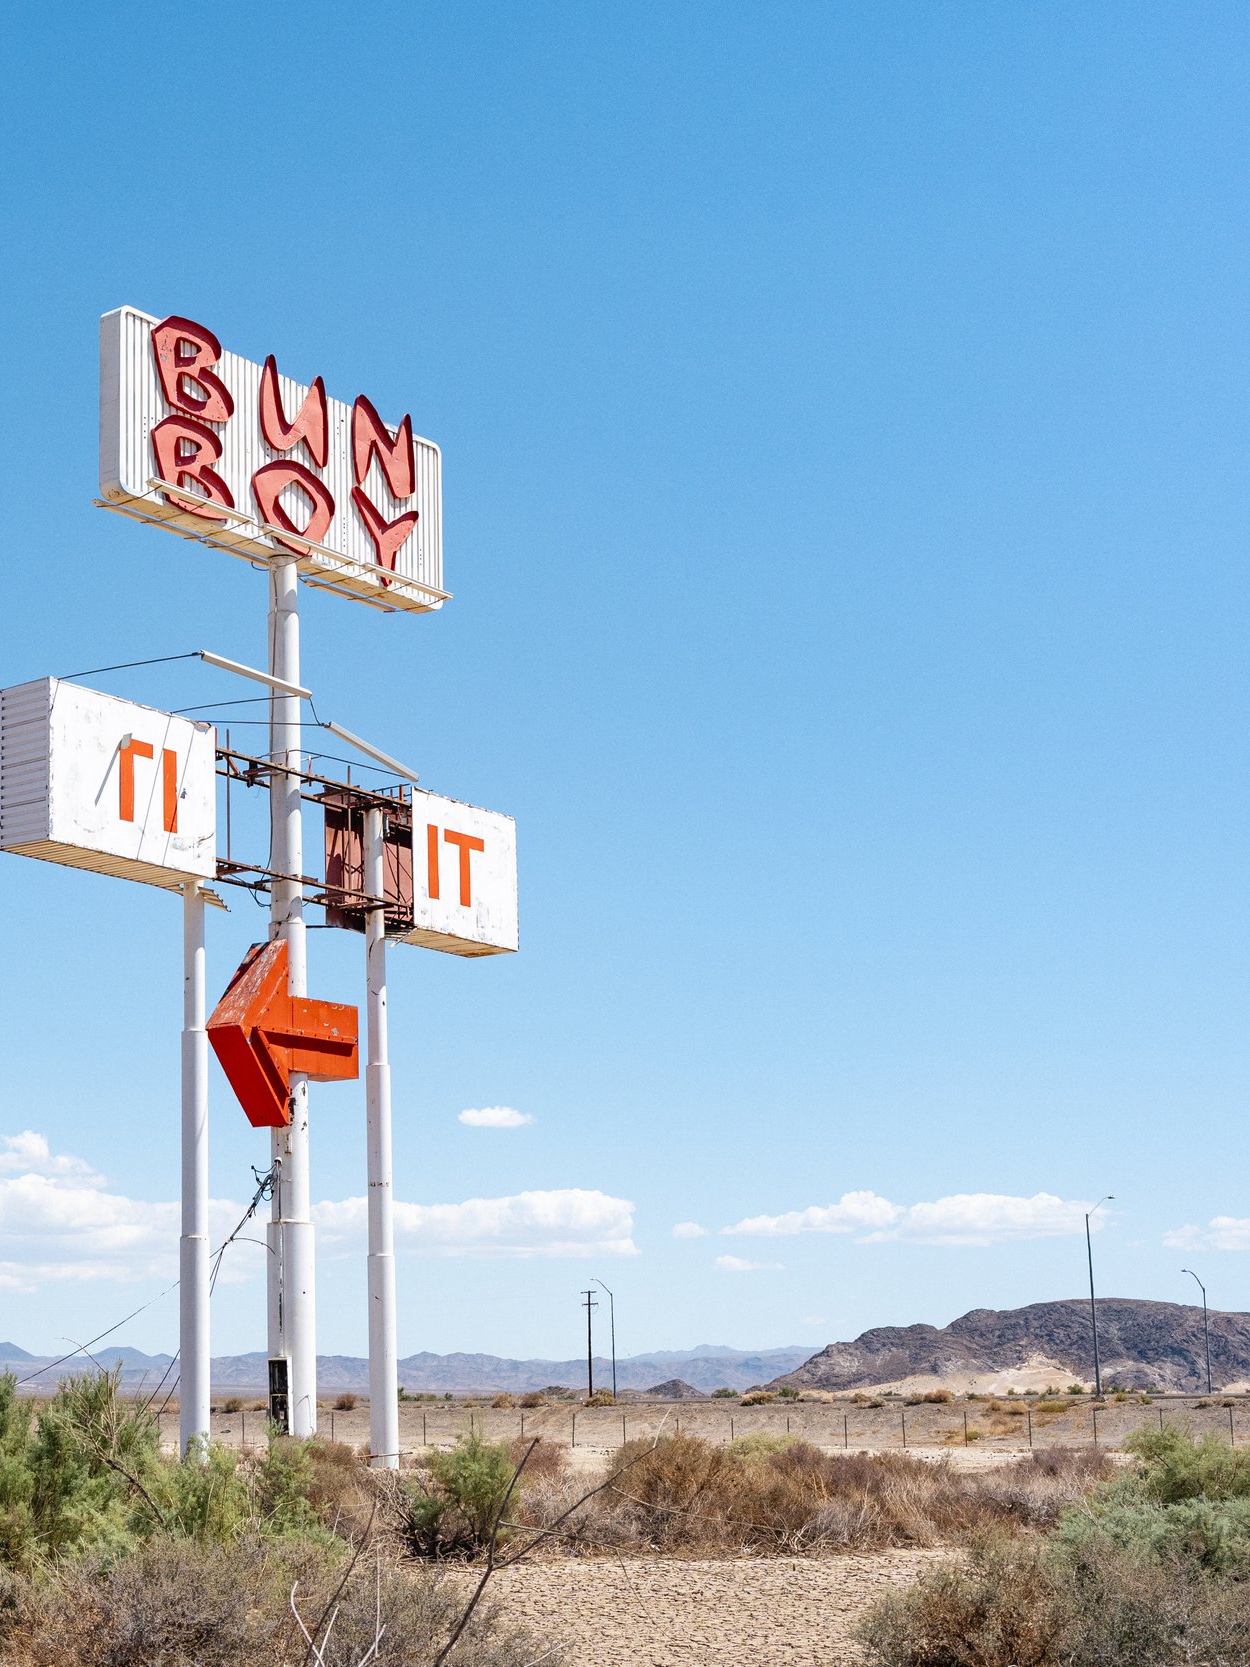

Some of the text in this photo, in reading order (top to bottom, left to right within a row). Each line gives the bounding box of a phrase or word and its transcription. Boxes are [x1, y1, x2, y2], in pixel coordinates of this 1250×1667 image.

[151, 315, 416, 499] BUN
[151, 414, 419, 587] BOY
[427, 823, 485, 908] IT
